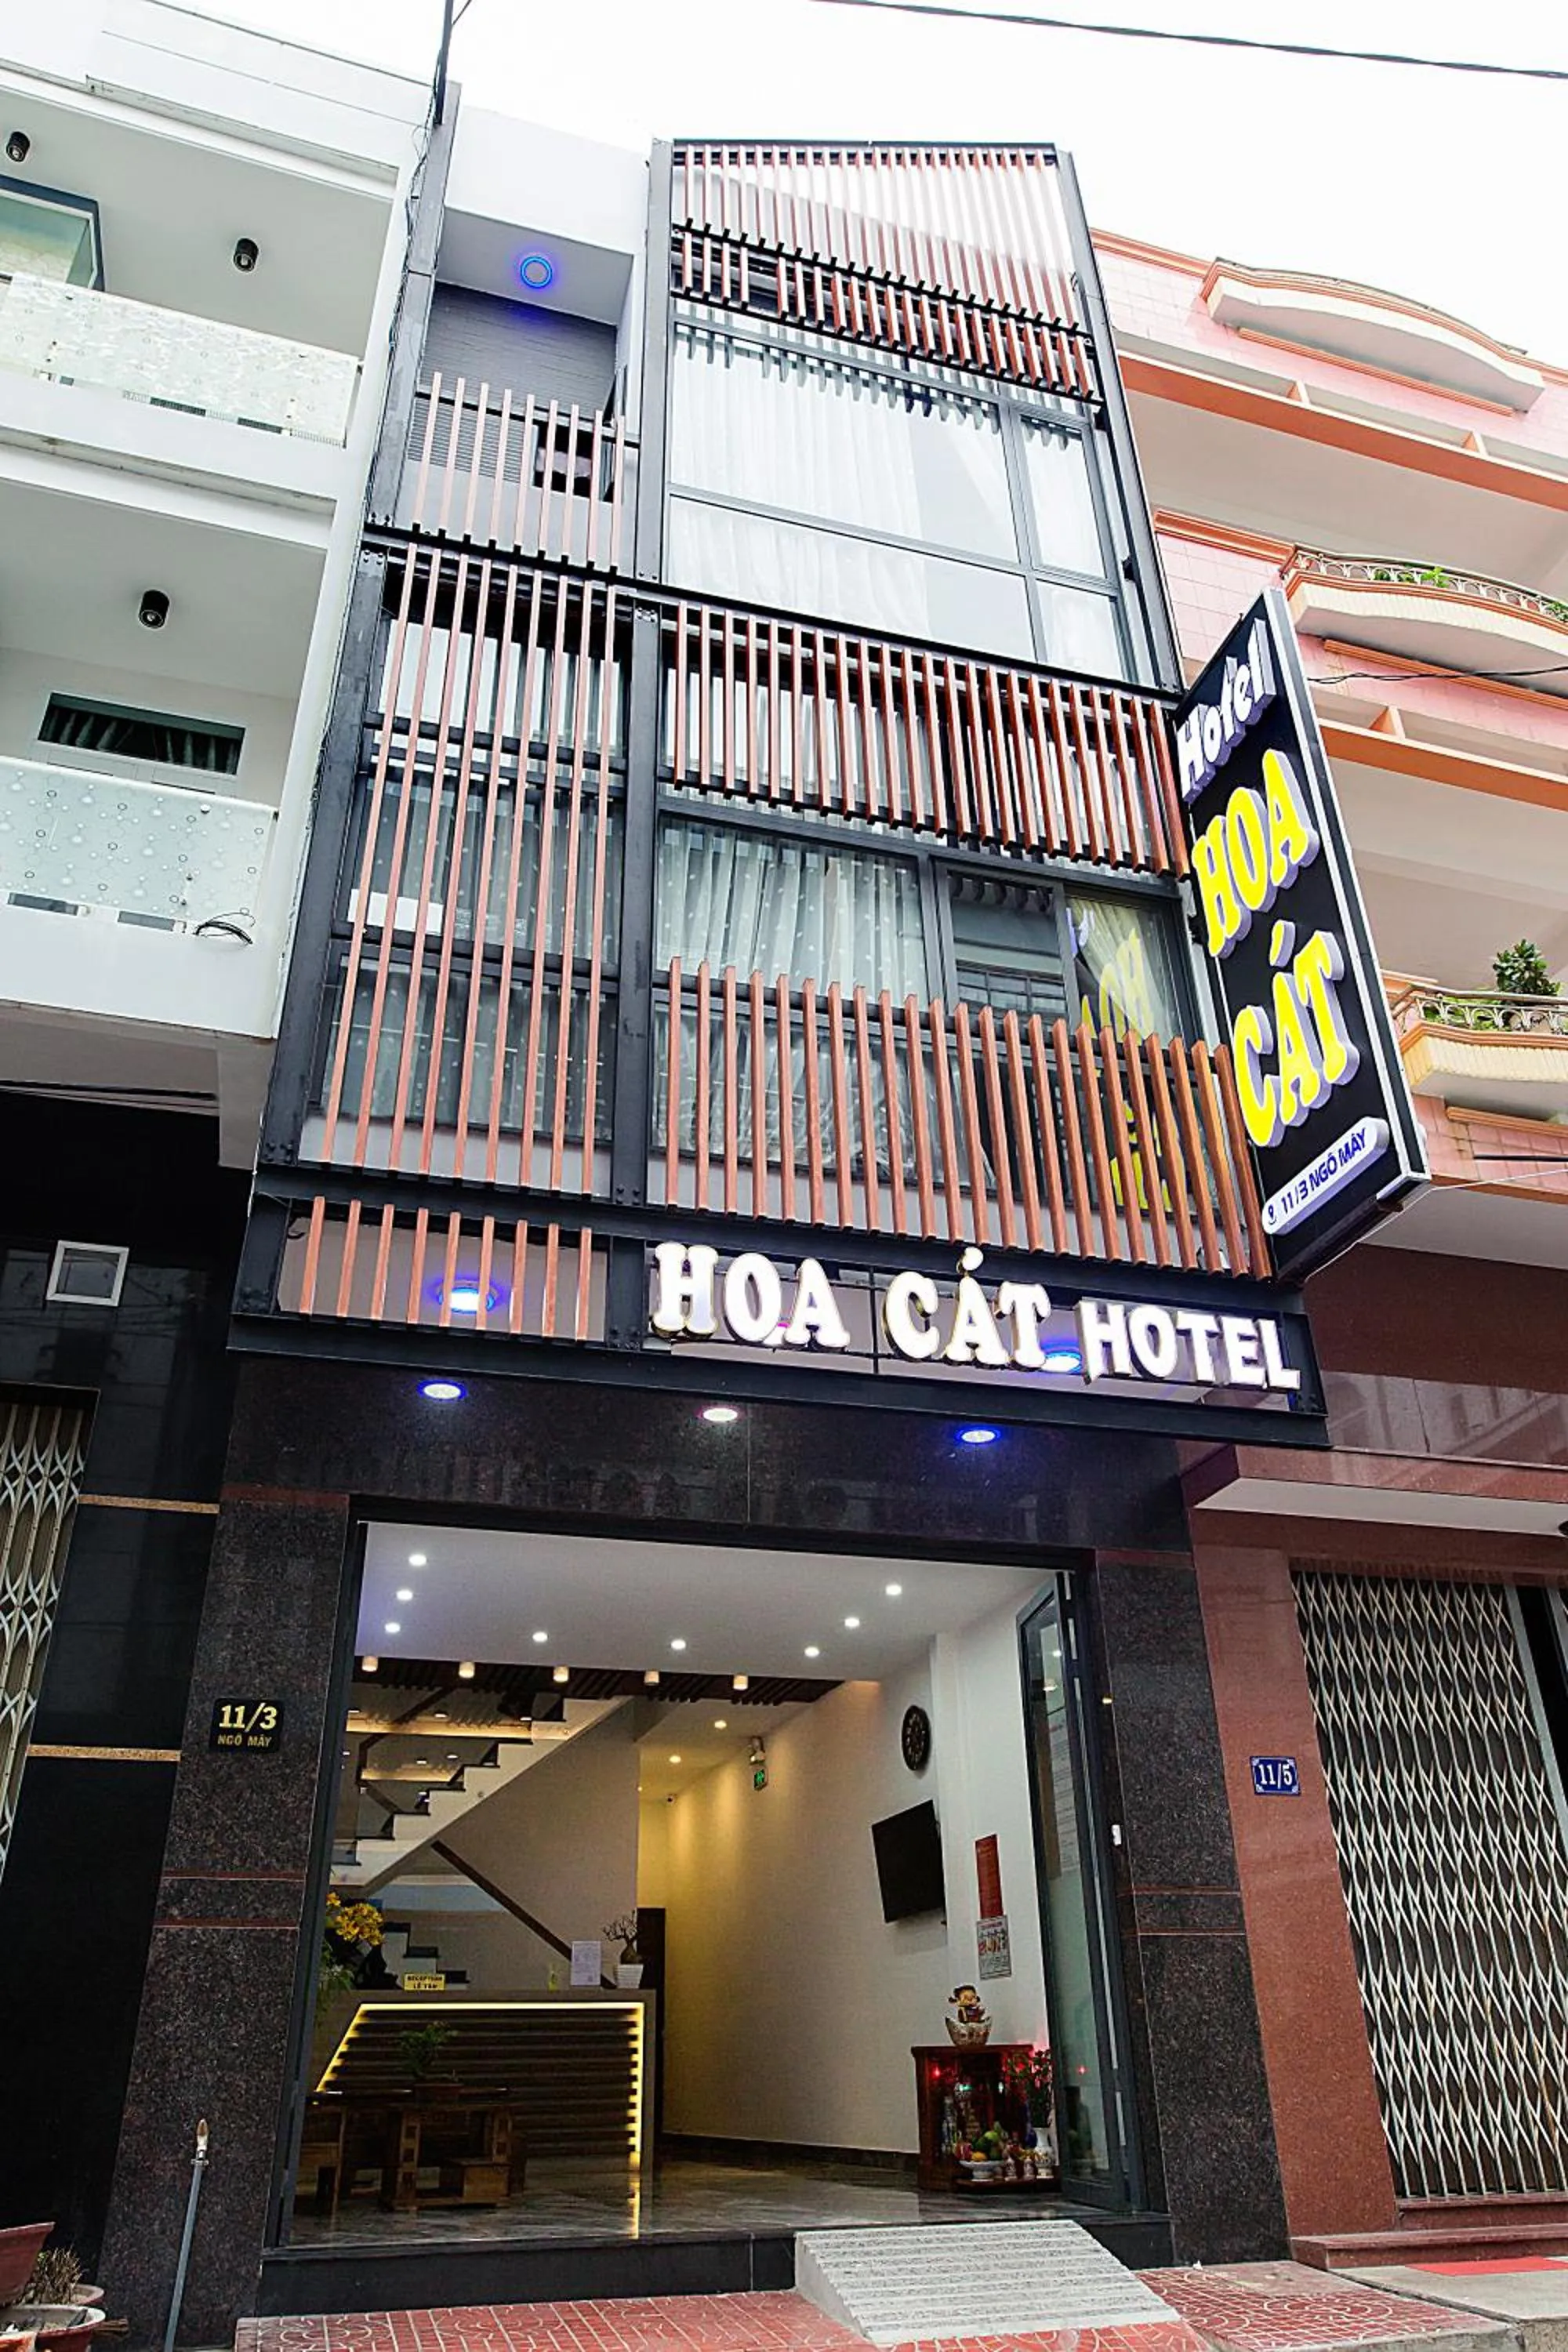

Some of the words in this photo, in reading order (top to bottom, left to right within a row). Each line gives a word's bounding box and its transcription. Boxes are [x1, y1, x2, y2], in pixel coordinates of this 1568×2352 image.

[1177, 618, 1273, 801] Hotel
[1192, 749, 1317, 958] HOA
[1232, 920, 1356, 1147] CÁT
[1280, 1179, 1309, 1214] 11/3
[1308, 1152, 1338, 1192] NGÔ
[1338, 1127, 1366, 1167] MÂY
[651, 1242, 851, 1351] HOA
[883, 1247, 1051, 1370] CÁT
[1075, 1298, 1301, 1390] HOTEL
[219, 1702, 277, 1733] 11/3
[1258, 1763, 1293, 1789] 11/5
